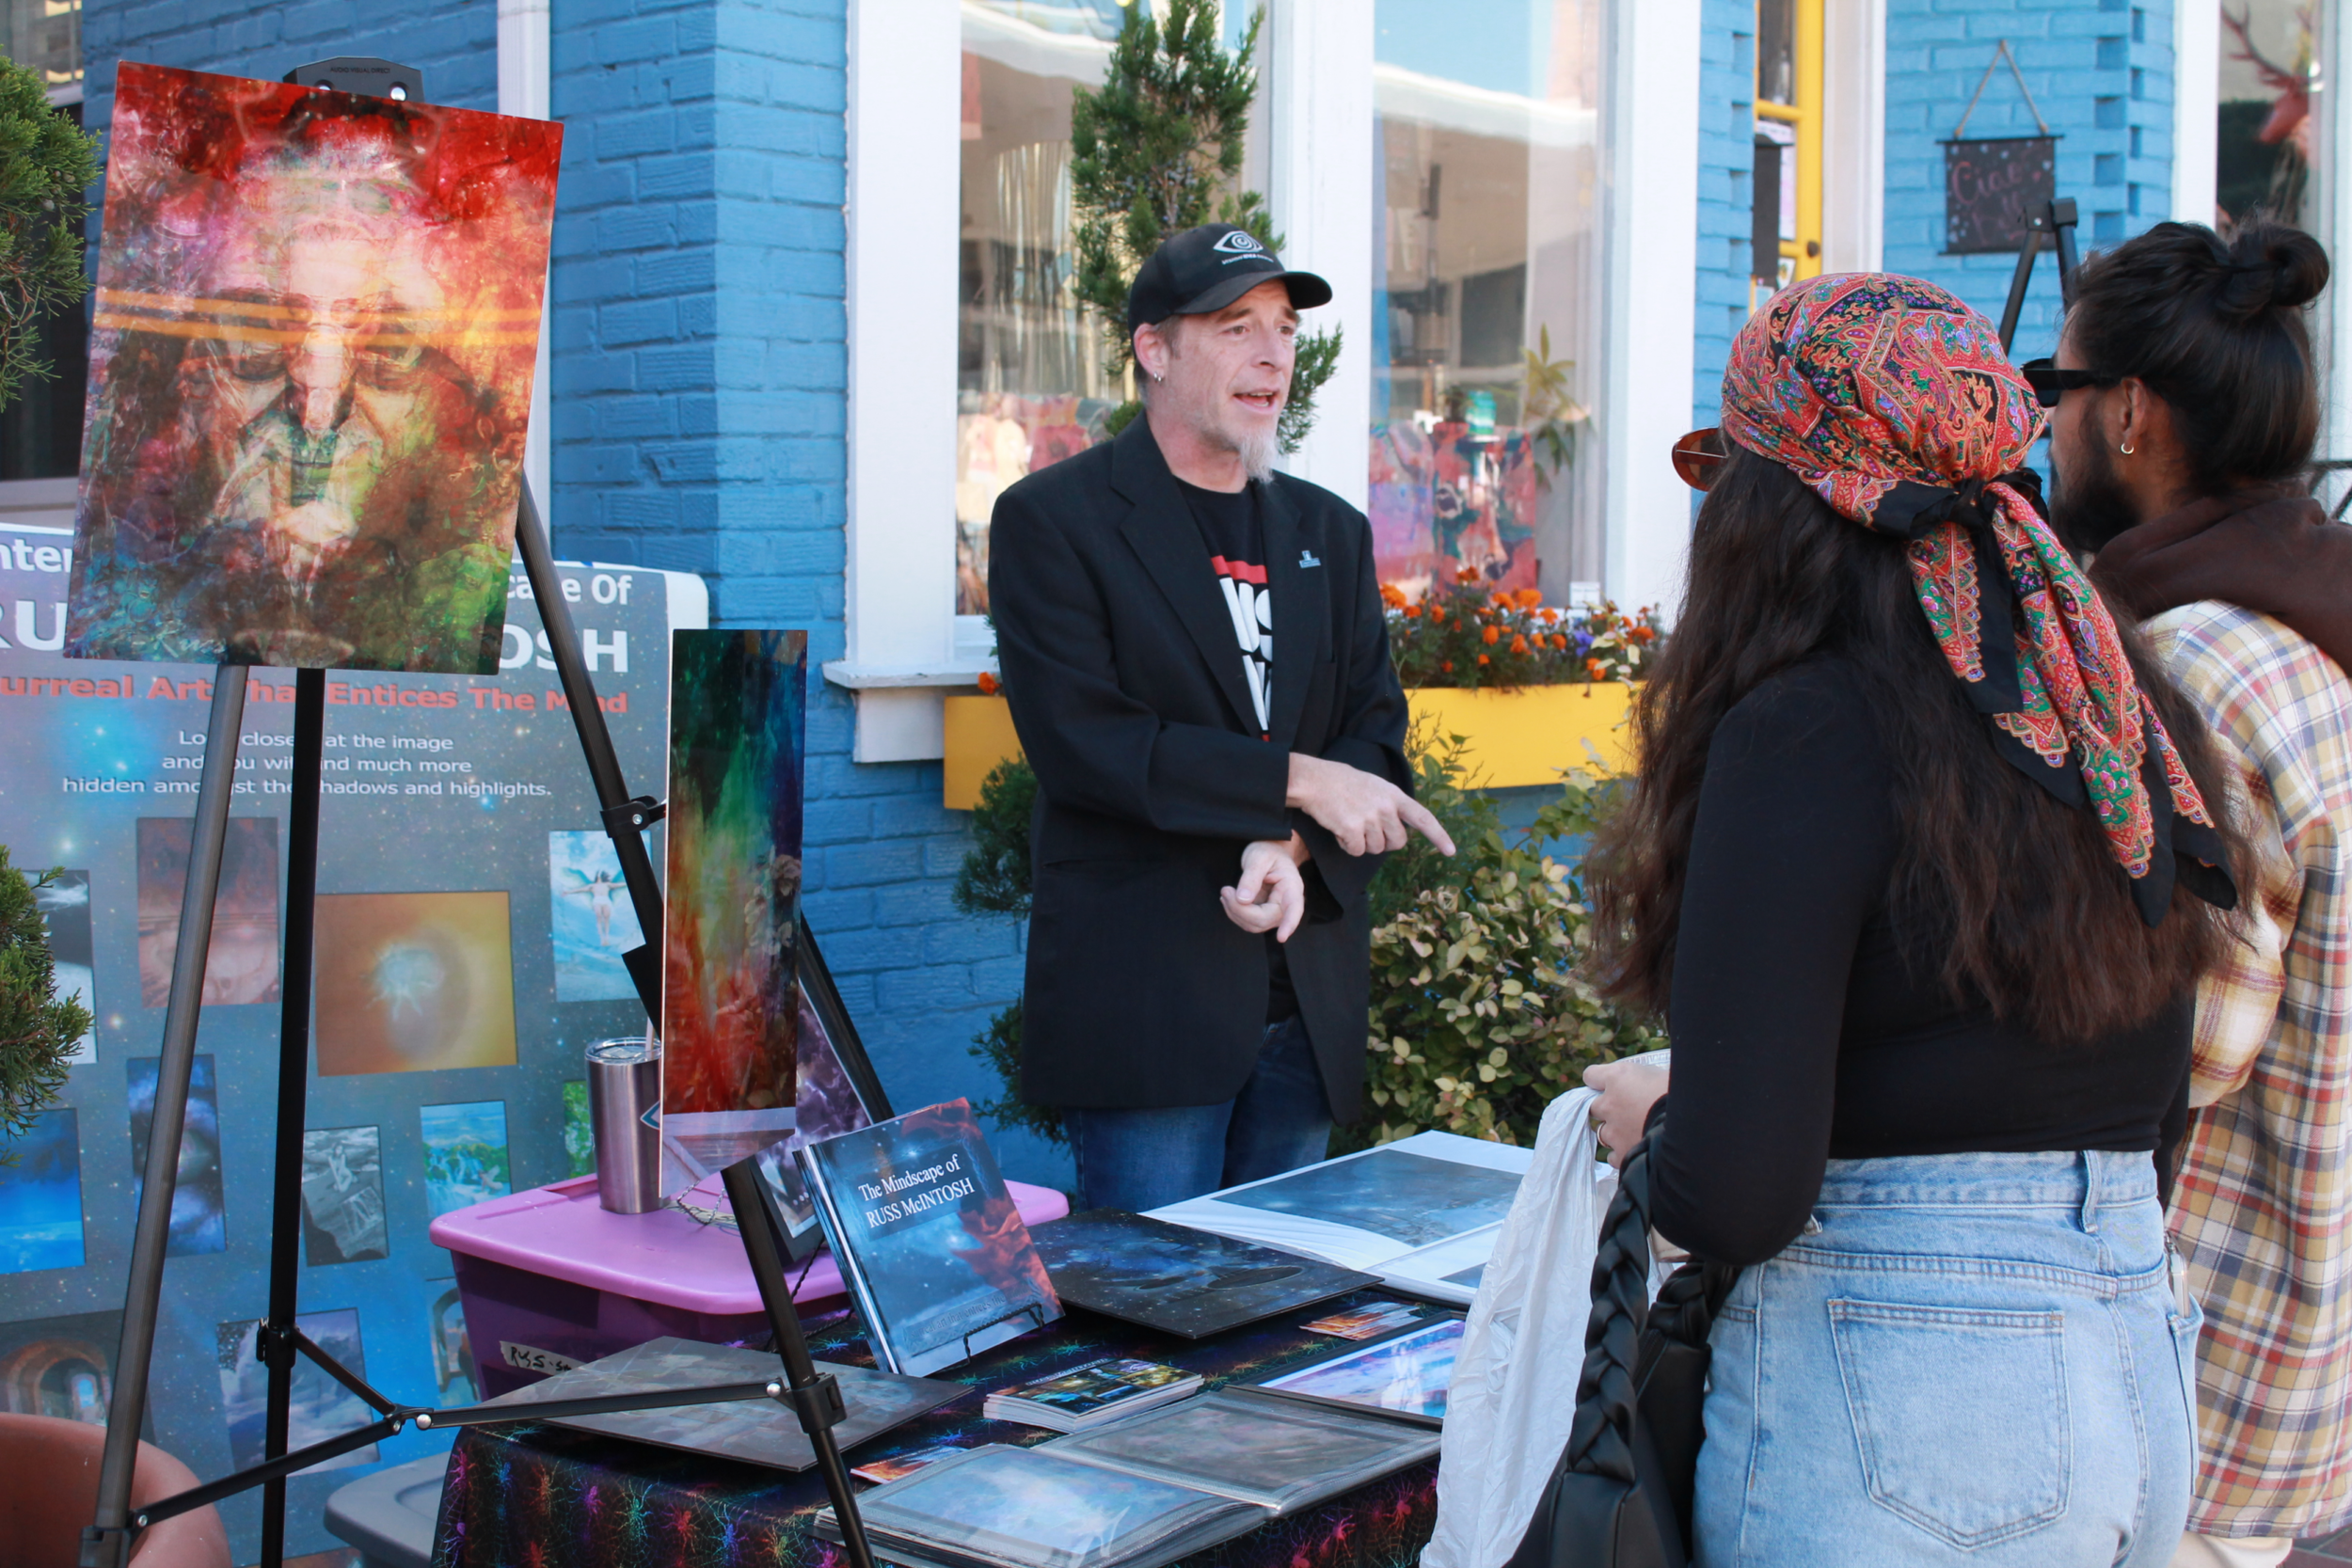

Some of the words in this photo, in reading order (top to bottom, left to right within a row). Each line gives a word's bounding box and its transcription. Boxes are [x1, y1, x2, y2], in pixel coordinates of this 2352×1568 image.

[591, 574, 633, 605] Of
[0, 674, 134, 699] urreal
[146, 676, 213, 702] Art
[246, 678, 296, 704] ha
[326, 681, 459, 708] Entices
[470, 687, 535, 711] The
[546, 689, 628, 714] Md
[241, 731, 294, 747] close
[325, 734, 347, 749] at
[353, 734, 387, 749] the
[391, 734, 454, 752] image
[358, 756, 412, 772] much
[420, 759, 472, 773] more
[62, 777, 145, 793] hidden
[320, 779, 399, 795] hadows
[405, 781, 443, 796] and
[450, 781, 552, 799] highlights.
[858, 1182, 883, 1202] The
[881, 1169, 945, 1195] Mindscape
[946, 1153, 961, 1173] of
[866, 1202, 902, 1228] RUSS
[900, 1177, 976, 1217] McINTOSH
